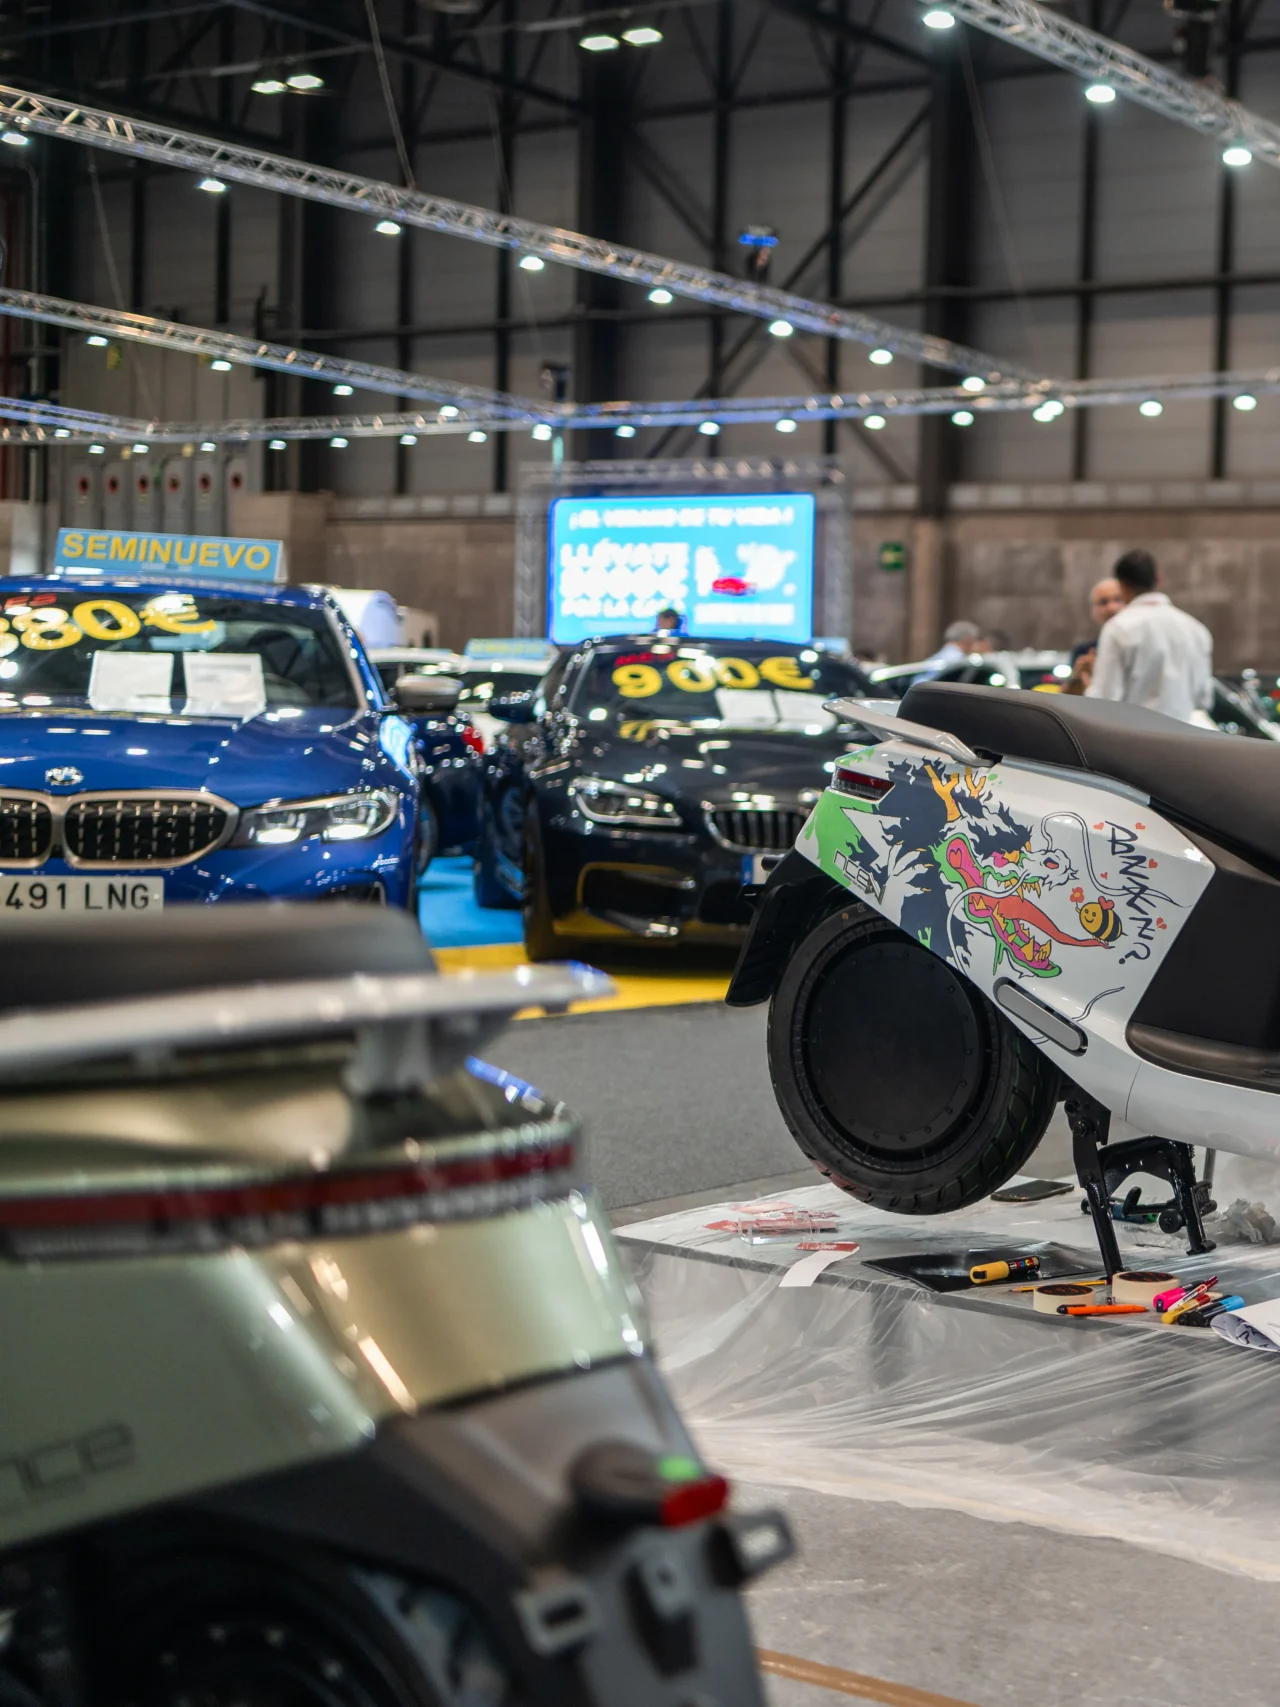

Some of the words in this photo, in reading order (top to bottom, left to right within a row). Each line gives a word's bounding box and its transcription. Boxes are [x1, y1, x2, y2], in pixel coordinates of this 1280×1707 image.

[62, 533, 271, 570] SEMINUEVO
[5, 881, 66, 910] 491
[84, 882, 149, 910] LNG
